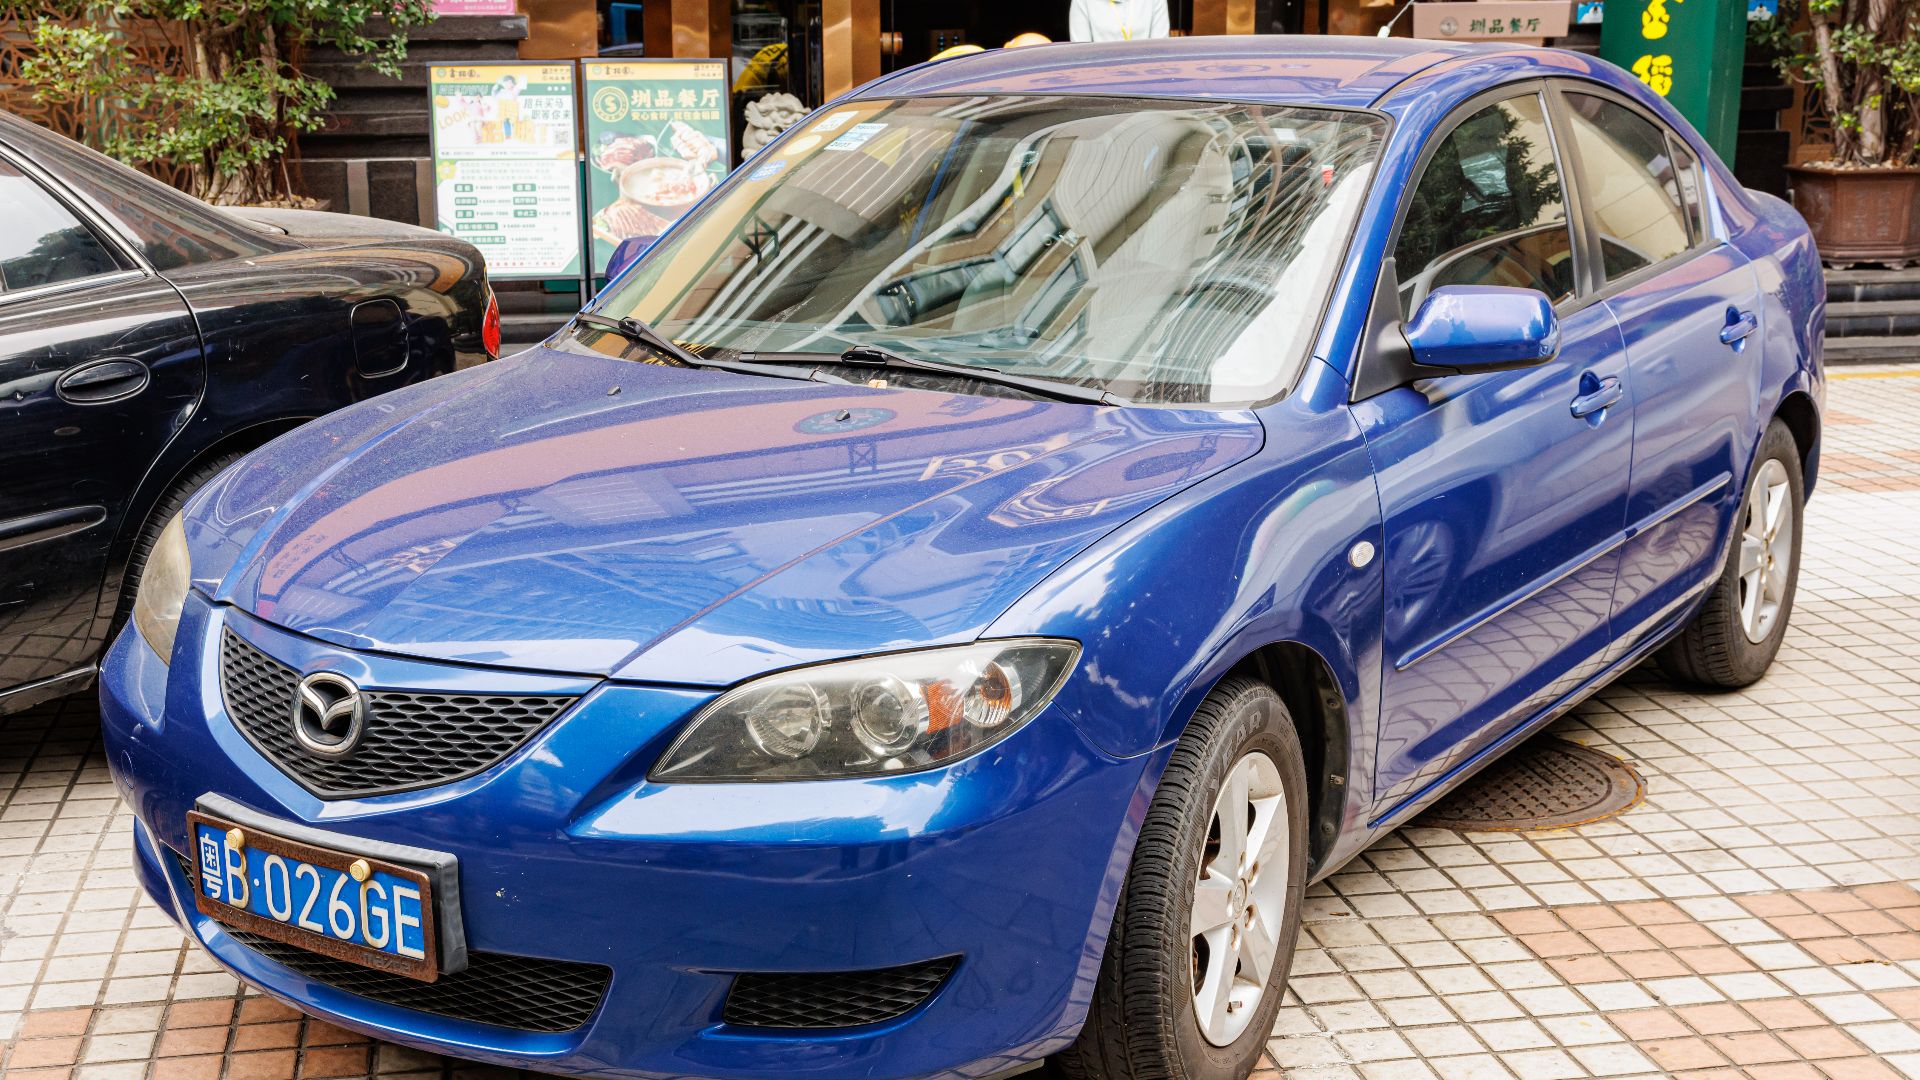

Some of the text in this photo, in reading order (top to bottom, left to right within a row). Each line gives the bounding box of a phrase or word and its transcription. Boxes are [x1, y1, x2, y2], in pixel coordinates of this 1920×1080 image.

[1469, 18, 1542, 34] 圳品餐厅
[631, 87, 720, 107] 圳品餐厅
[438, 107, 470, 131] LOOK
[531, 109, 572, 121] 职等你来
[199, 834, 425, 961] 粤B·026GE
